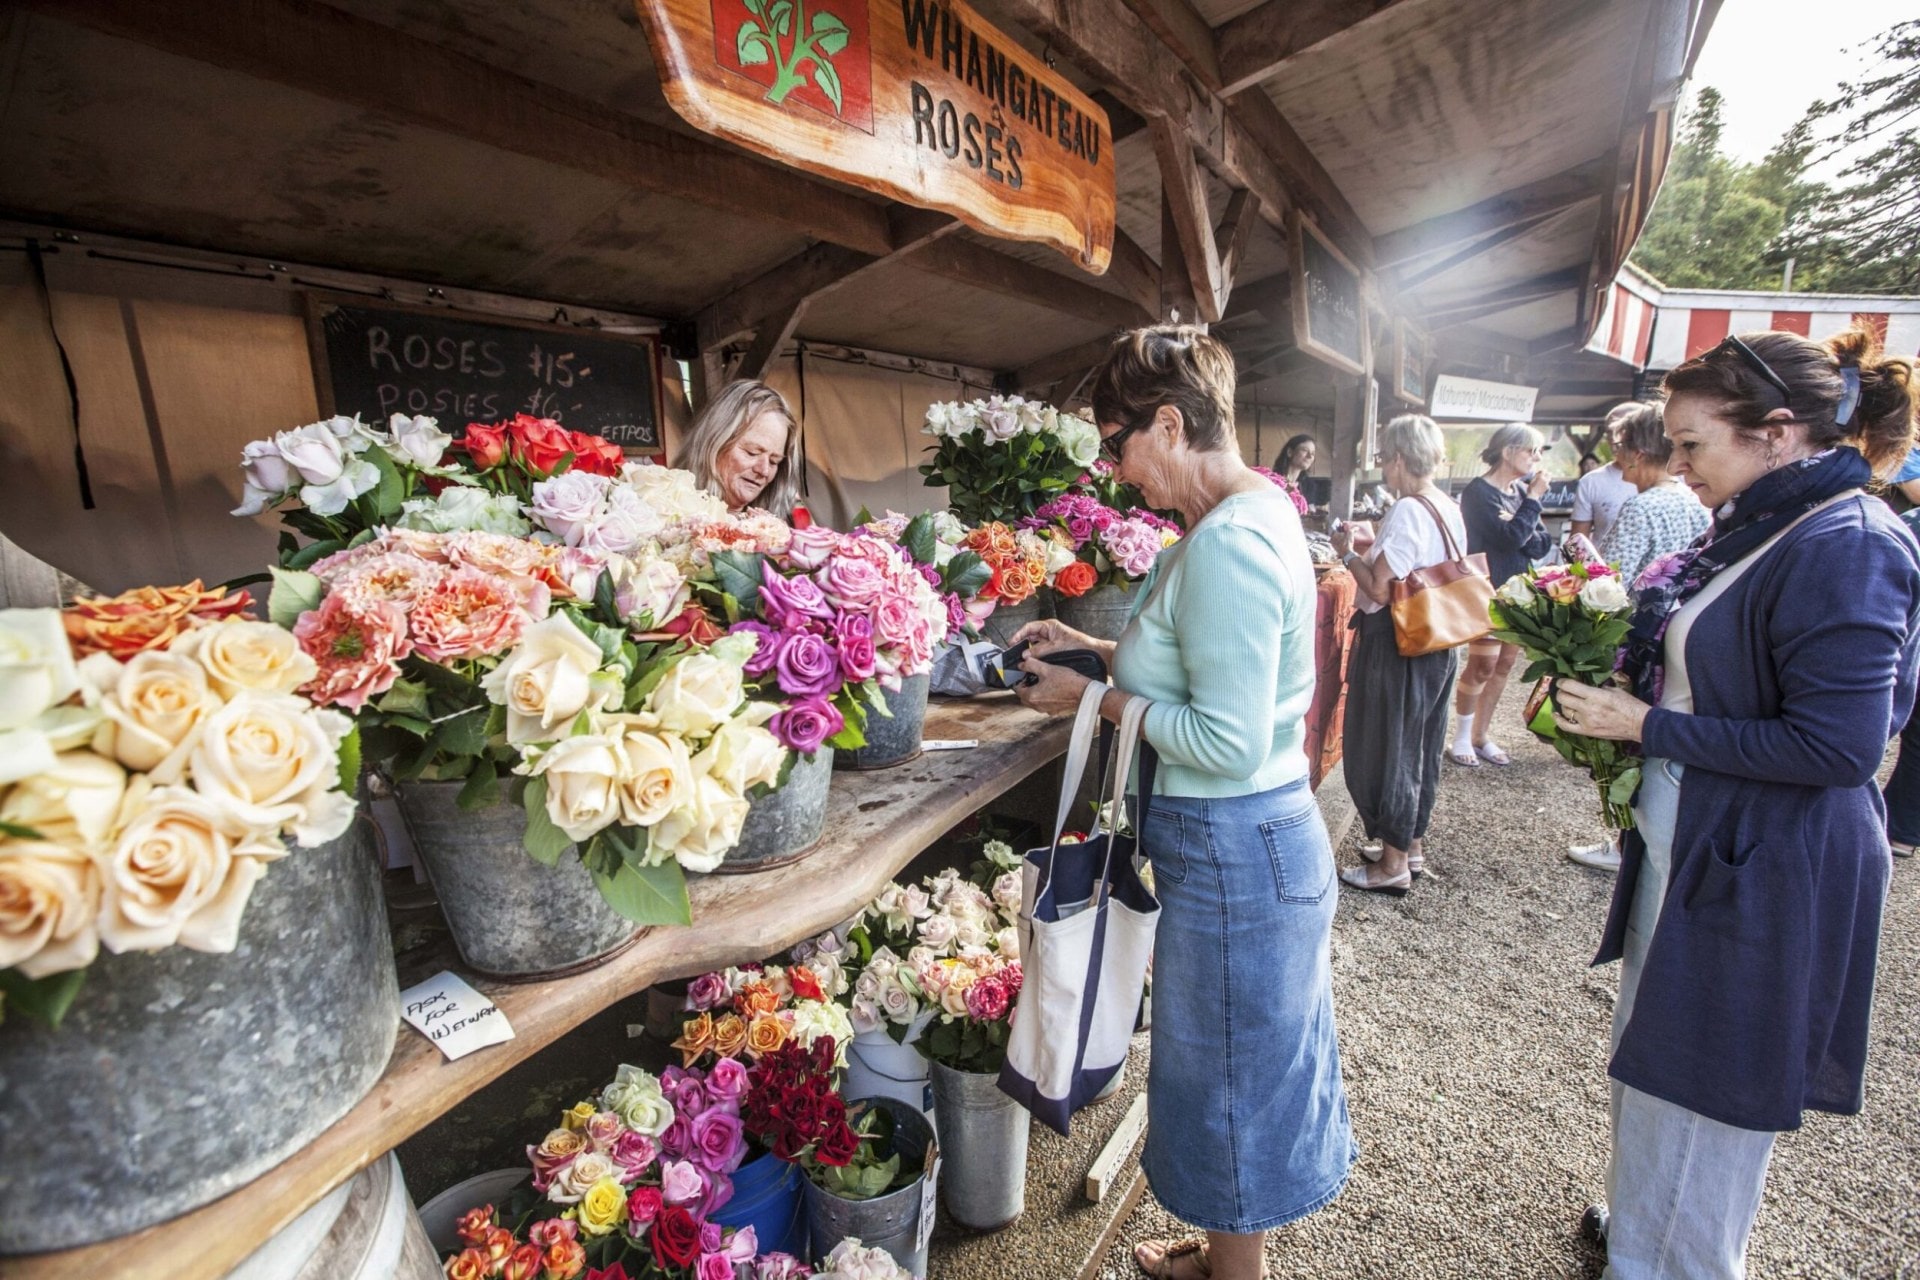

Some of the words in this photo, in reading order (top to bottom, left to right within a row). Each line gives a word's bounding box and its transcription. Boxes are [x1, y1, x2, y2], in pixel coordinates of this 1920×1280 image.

[902, 0, 1099, 167] WHANGATEAU
[911, 80, 1023, 190] ROSES
[367, 325, 507, 378] ROSES
[377, 384, 500, 419] POSIES
[601, 424, 653, 442] EFTPOS
[406, 991, 447, 1017] ASK
[424, 1002, 460, 1026] FOR
